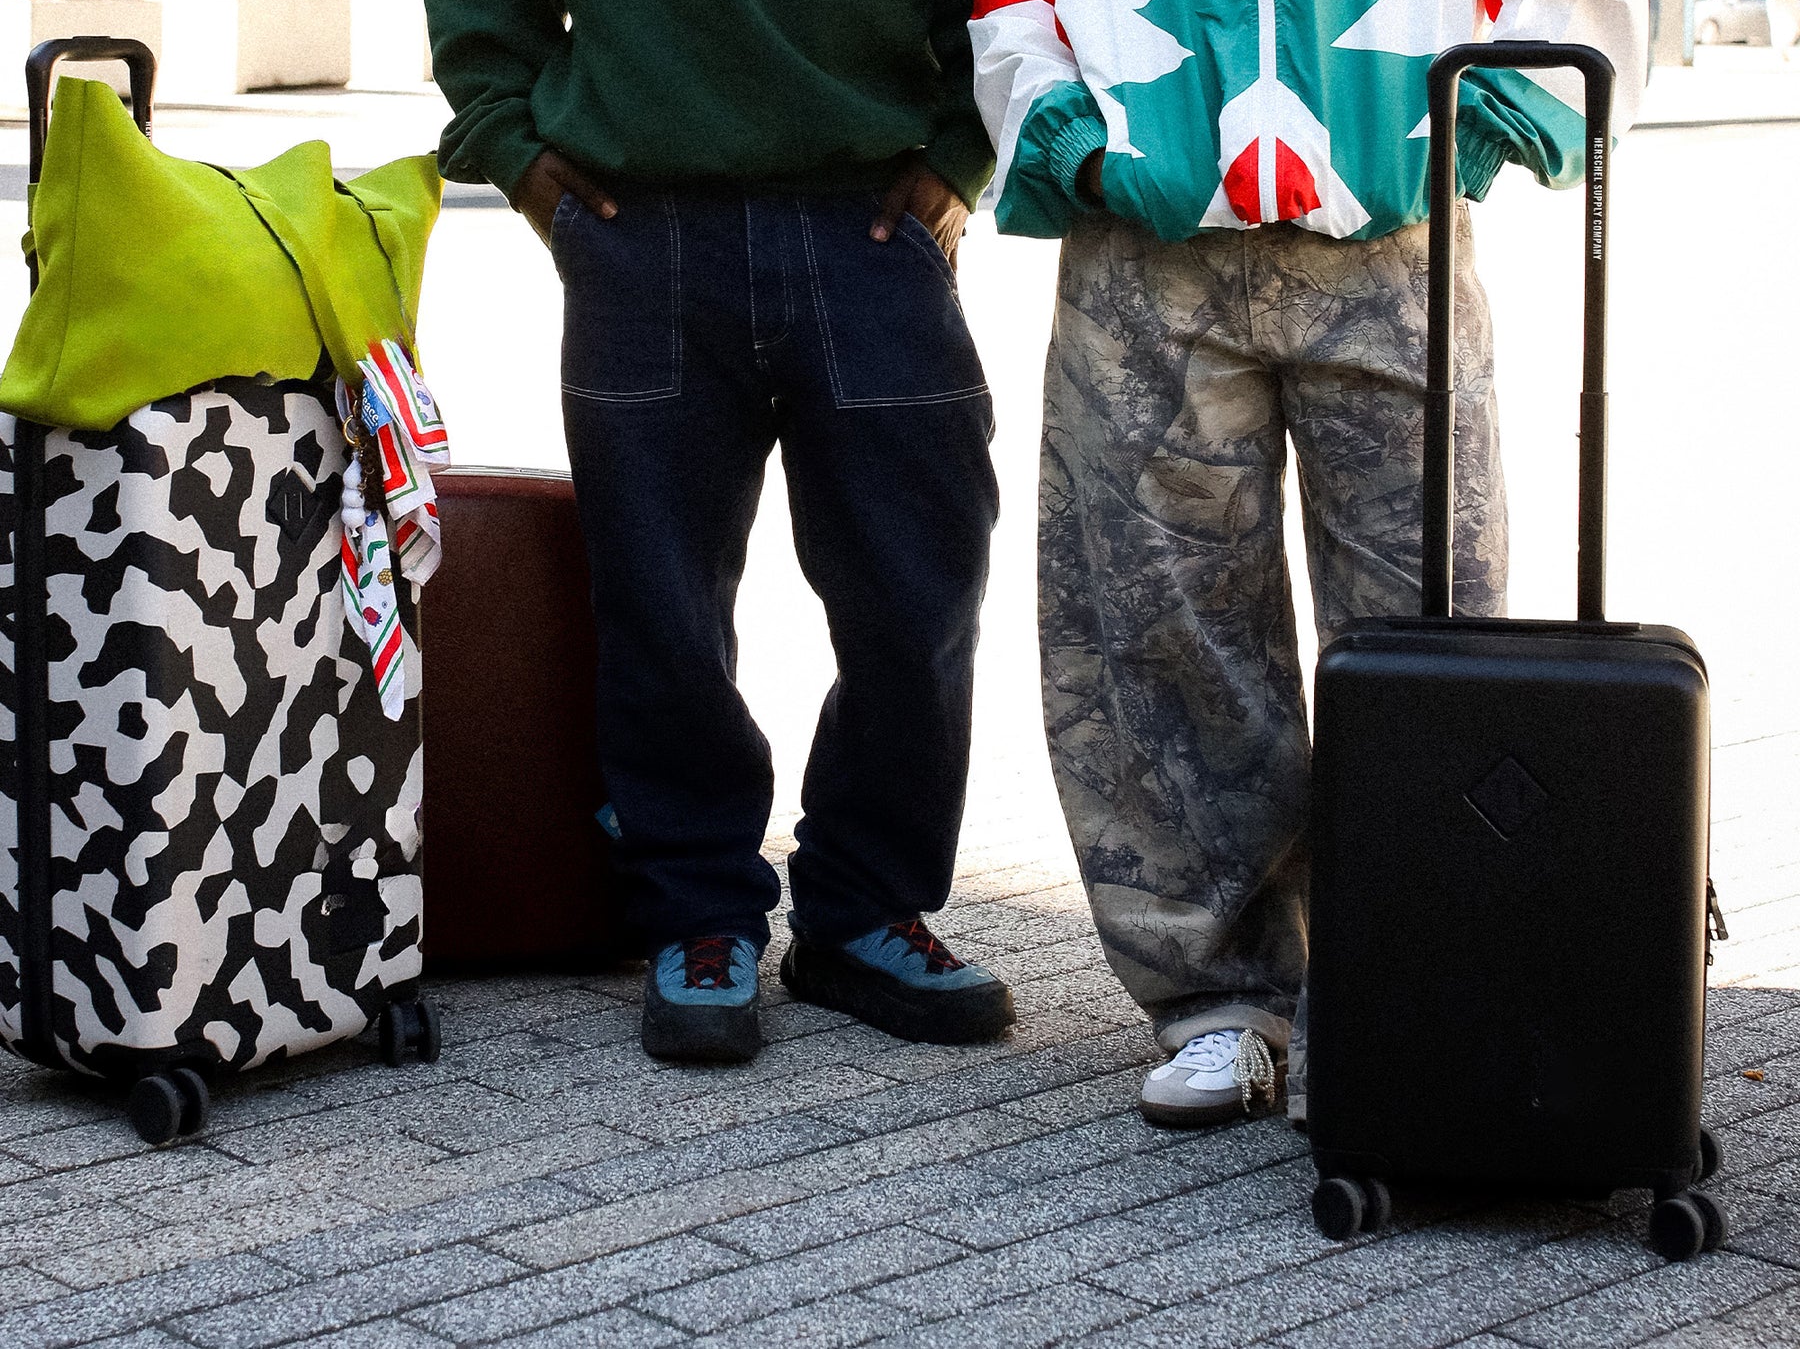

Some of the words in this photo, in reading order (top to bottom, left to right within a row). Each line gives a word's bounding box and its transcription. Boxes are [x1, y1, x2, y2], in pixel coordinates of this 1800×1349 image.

[1593, 137, 1604, 182] HERSCHEL
[1593, 184, 1603, 217] SUPPLY
[1592, 219, 1602, 260] COMPANY
